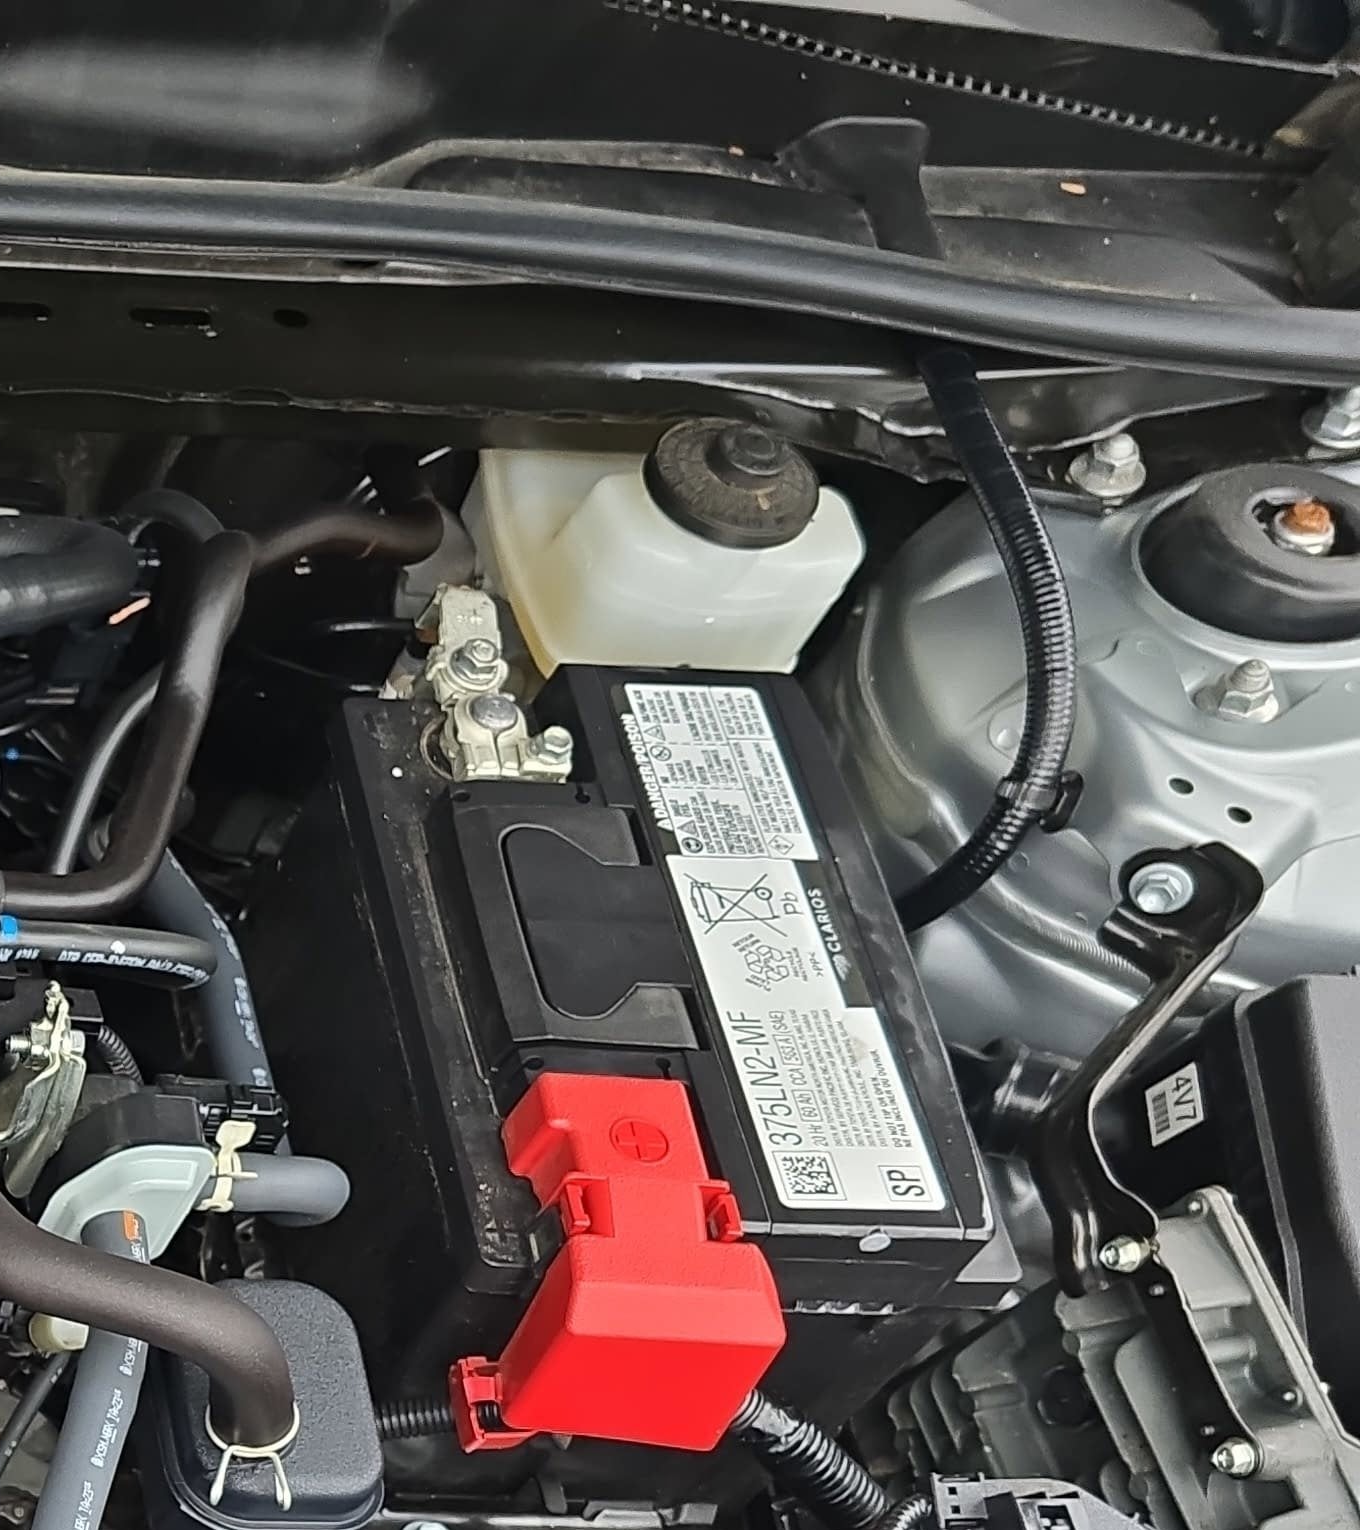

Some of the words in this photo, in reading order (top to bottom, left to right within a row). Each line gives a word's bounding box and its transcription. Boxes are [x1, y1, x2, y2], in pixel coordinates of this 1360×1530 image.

[776, 891, 804, 915] Pb
[804, 887, 845, 952] CLARIOS
[723, 1009, 806, 1145] 375LN2-MF
[786, 1067, 809, 1086] CCA
[1172, 1077, 1197, 1121] 4V7
[884, 1169, 926, 1197] SP
